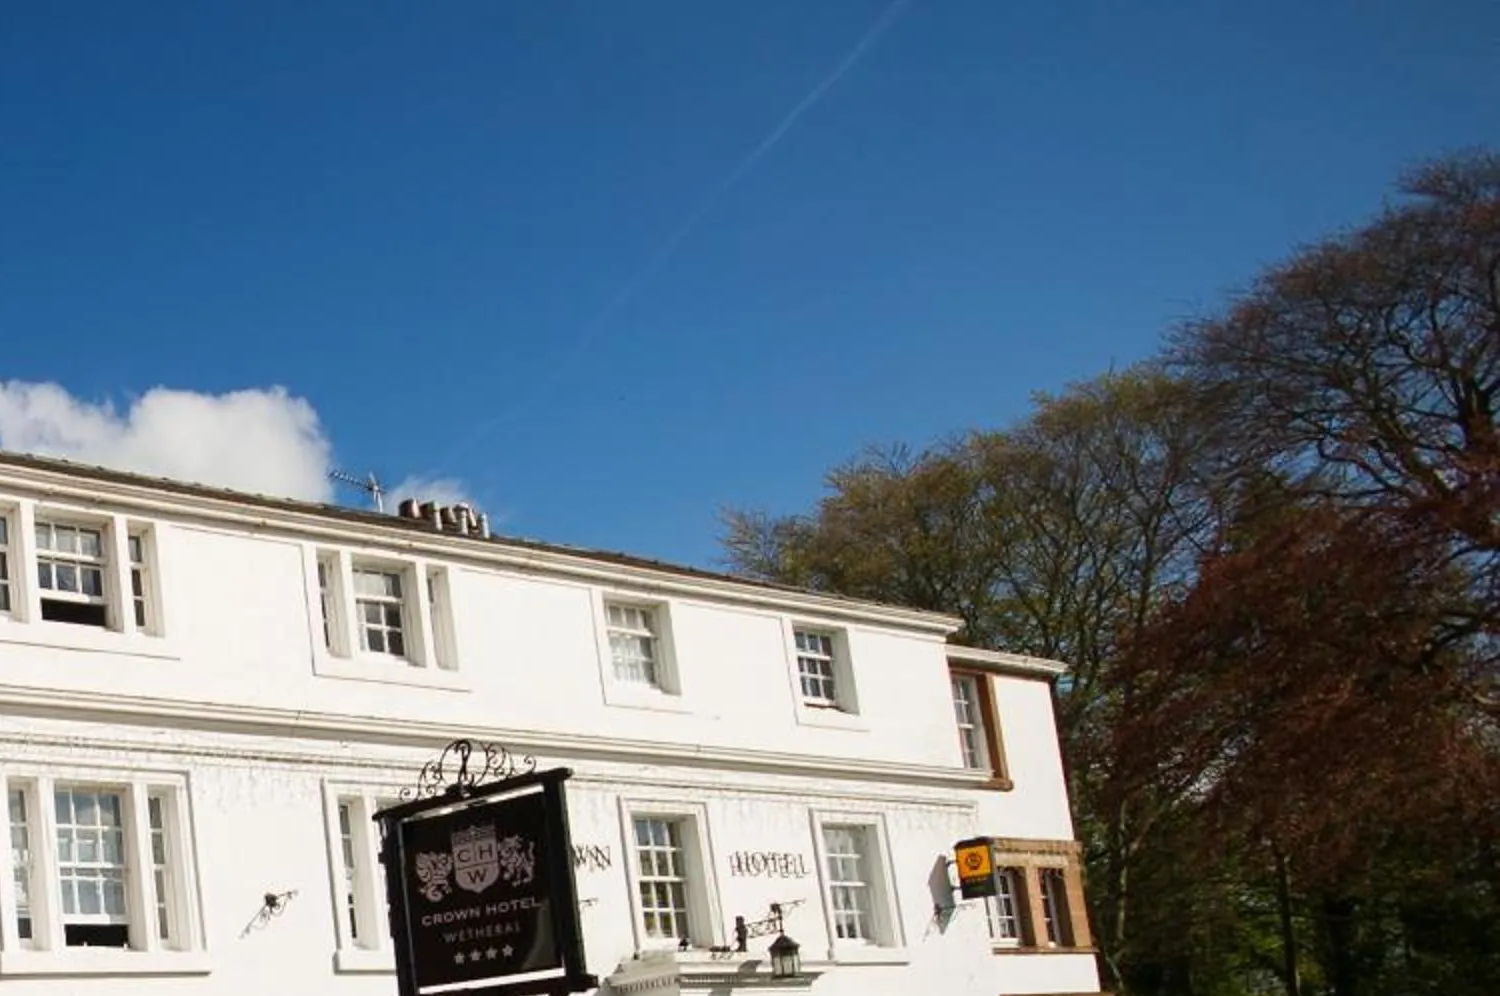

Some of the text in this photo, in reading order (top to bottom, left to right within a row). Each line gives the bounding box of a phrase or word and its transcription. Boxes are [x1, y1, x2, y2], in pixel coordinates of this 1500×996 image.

[729, 850, 809, 878] HOTEL
[421, 896, 541, 927] CROWN HOTEL
[442, 921, 520, 943] WETHERAL
